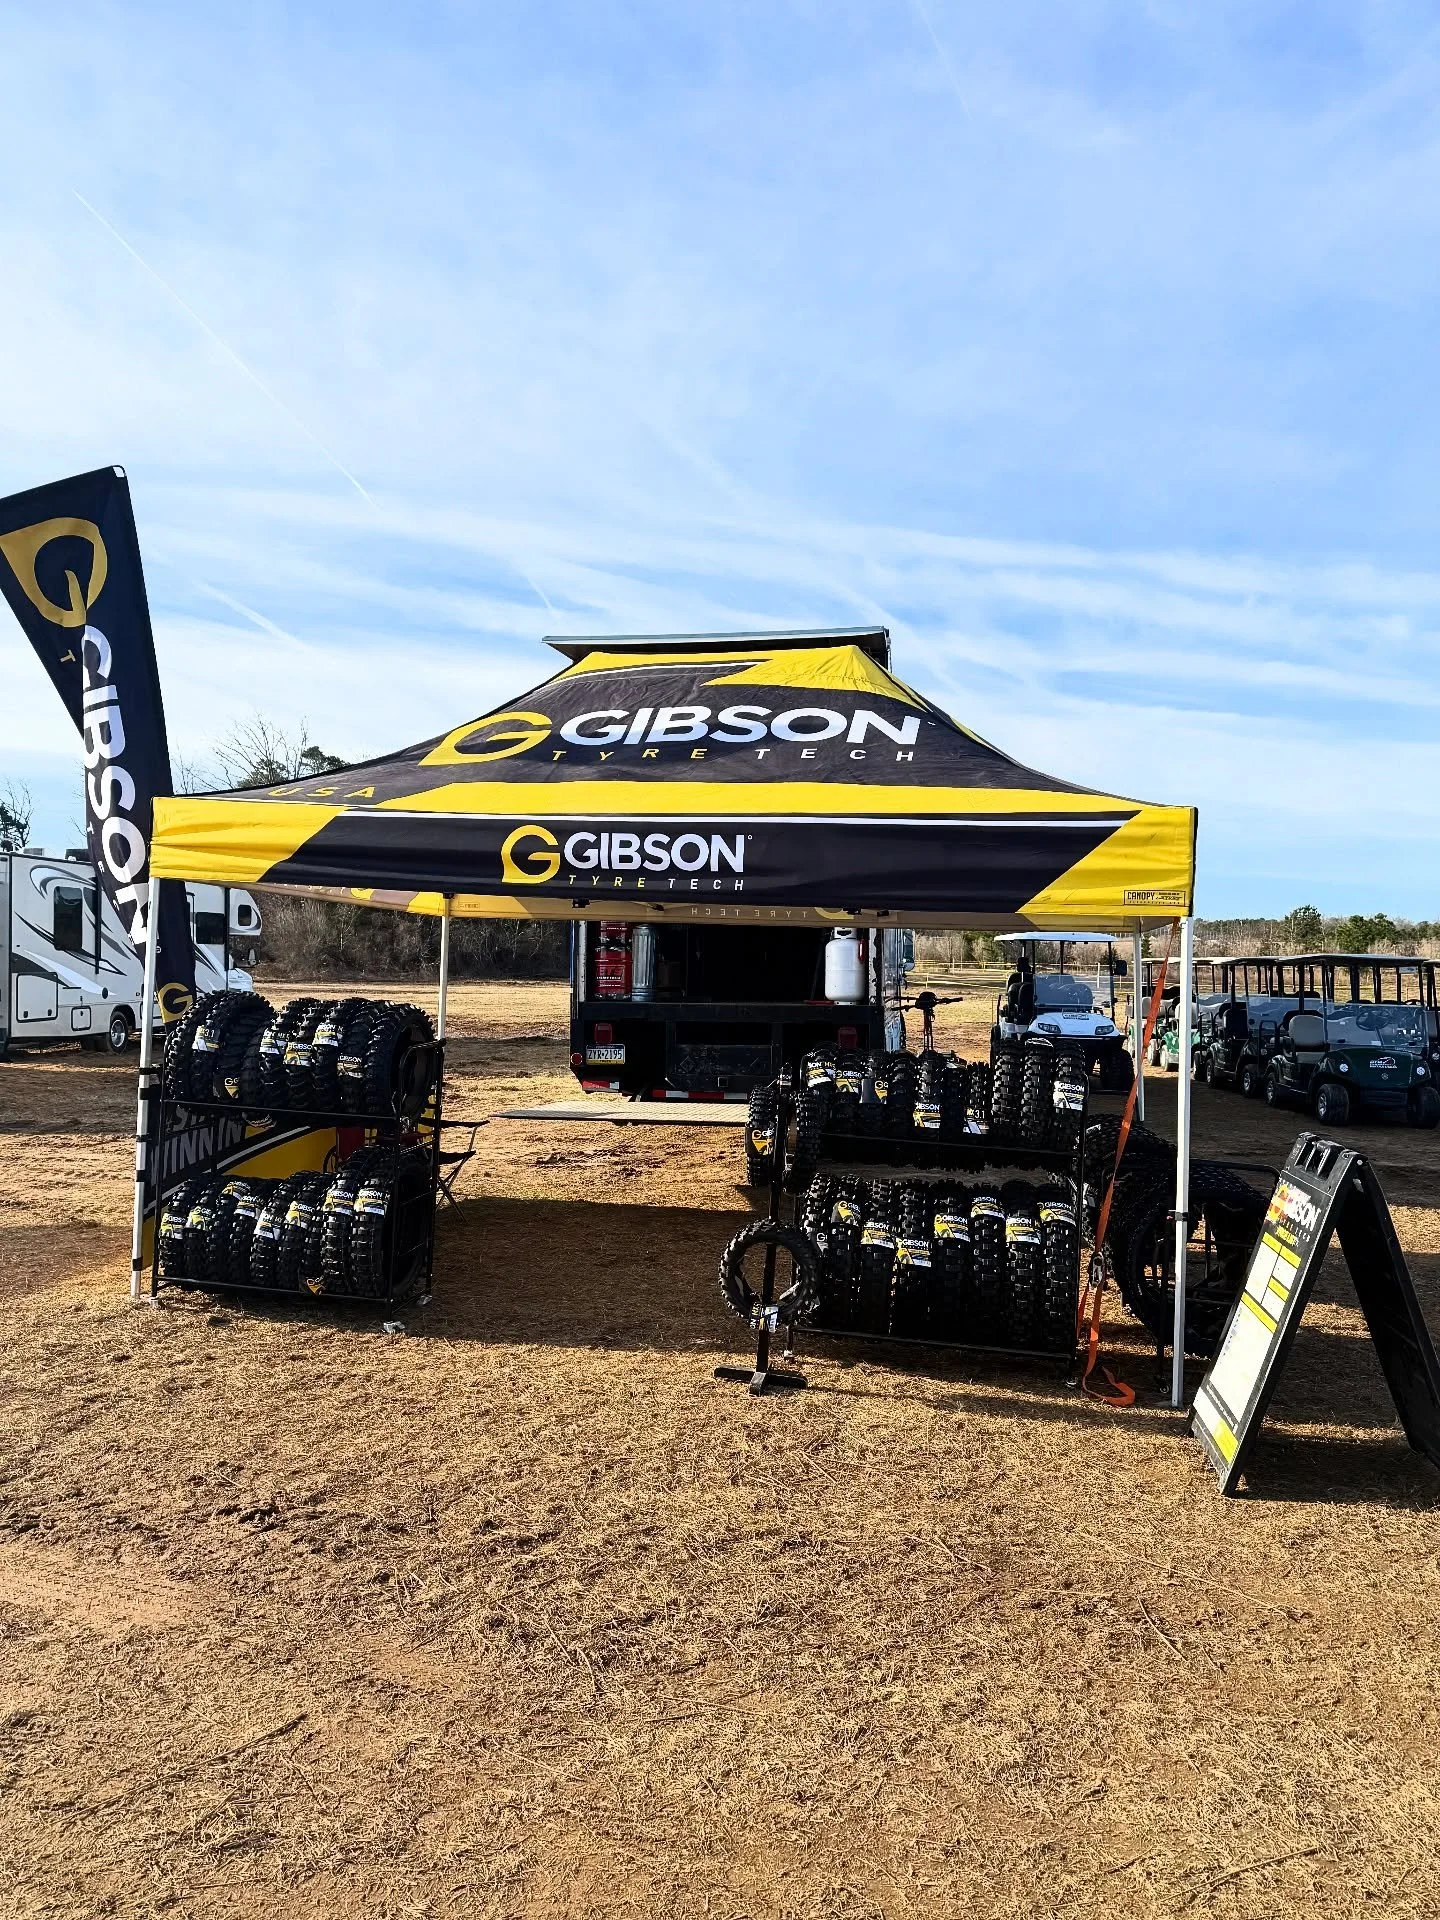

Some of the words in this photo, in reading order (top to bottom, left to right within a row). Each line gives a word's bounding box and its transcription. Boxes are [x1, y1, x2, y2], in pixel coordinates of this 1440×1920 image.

[560, 705, 921, 746] GIBSON
[552, 748, 707, 761] TYRE
[755, 748, 914, 762] TECH
[268, 786, 375, 798] USA
[563, 831, 745, 873] GIBSON
[569, 875, 646, 888] TYRE
[667, 878, 744, 891] TECH
[1127, 891, 1155, 901] CANOPY
[1060, 1082, 1085, 1092] GIBSON
[941, 1215, 968, 1224] GIBSON
[903, 1238, 930, 1248] GIBSON
